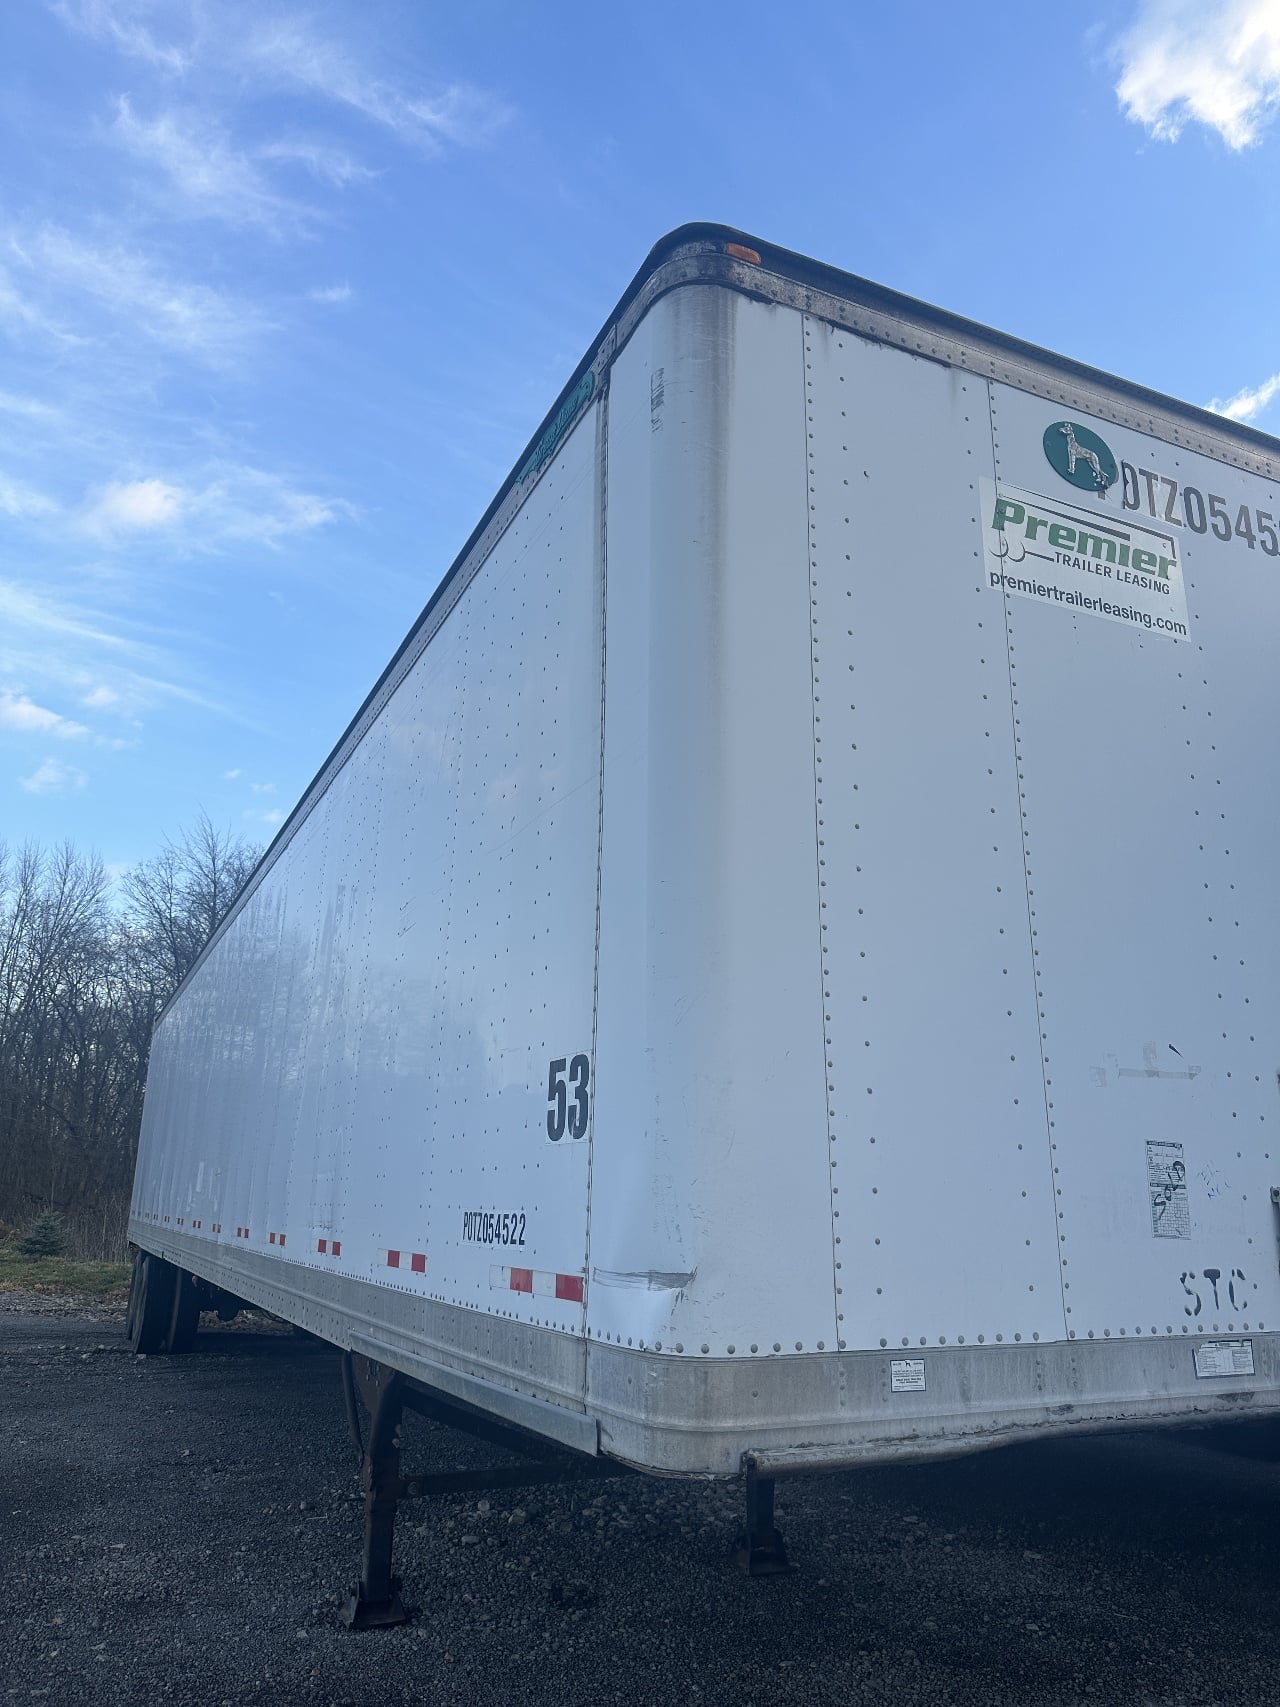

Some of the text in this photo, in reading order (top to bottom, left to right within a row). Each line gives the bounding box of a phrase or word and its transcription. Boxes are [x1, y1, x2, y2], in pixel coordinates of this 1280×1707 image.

[992, 498, 1177, 580] Premier
[989, 571, 1187, 635] premiertrailerleasing.com
[1054, 551, 1170, 595] TRAILER LEASING
[547, 1053, 589, 1141] 53
[463, 1211, 525, 1246] POTZ054522
